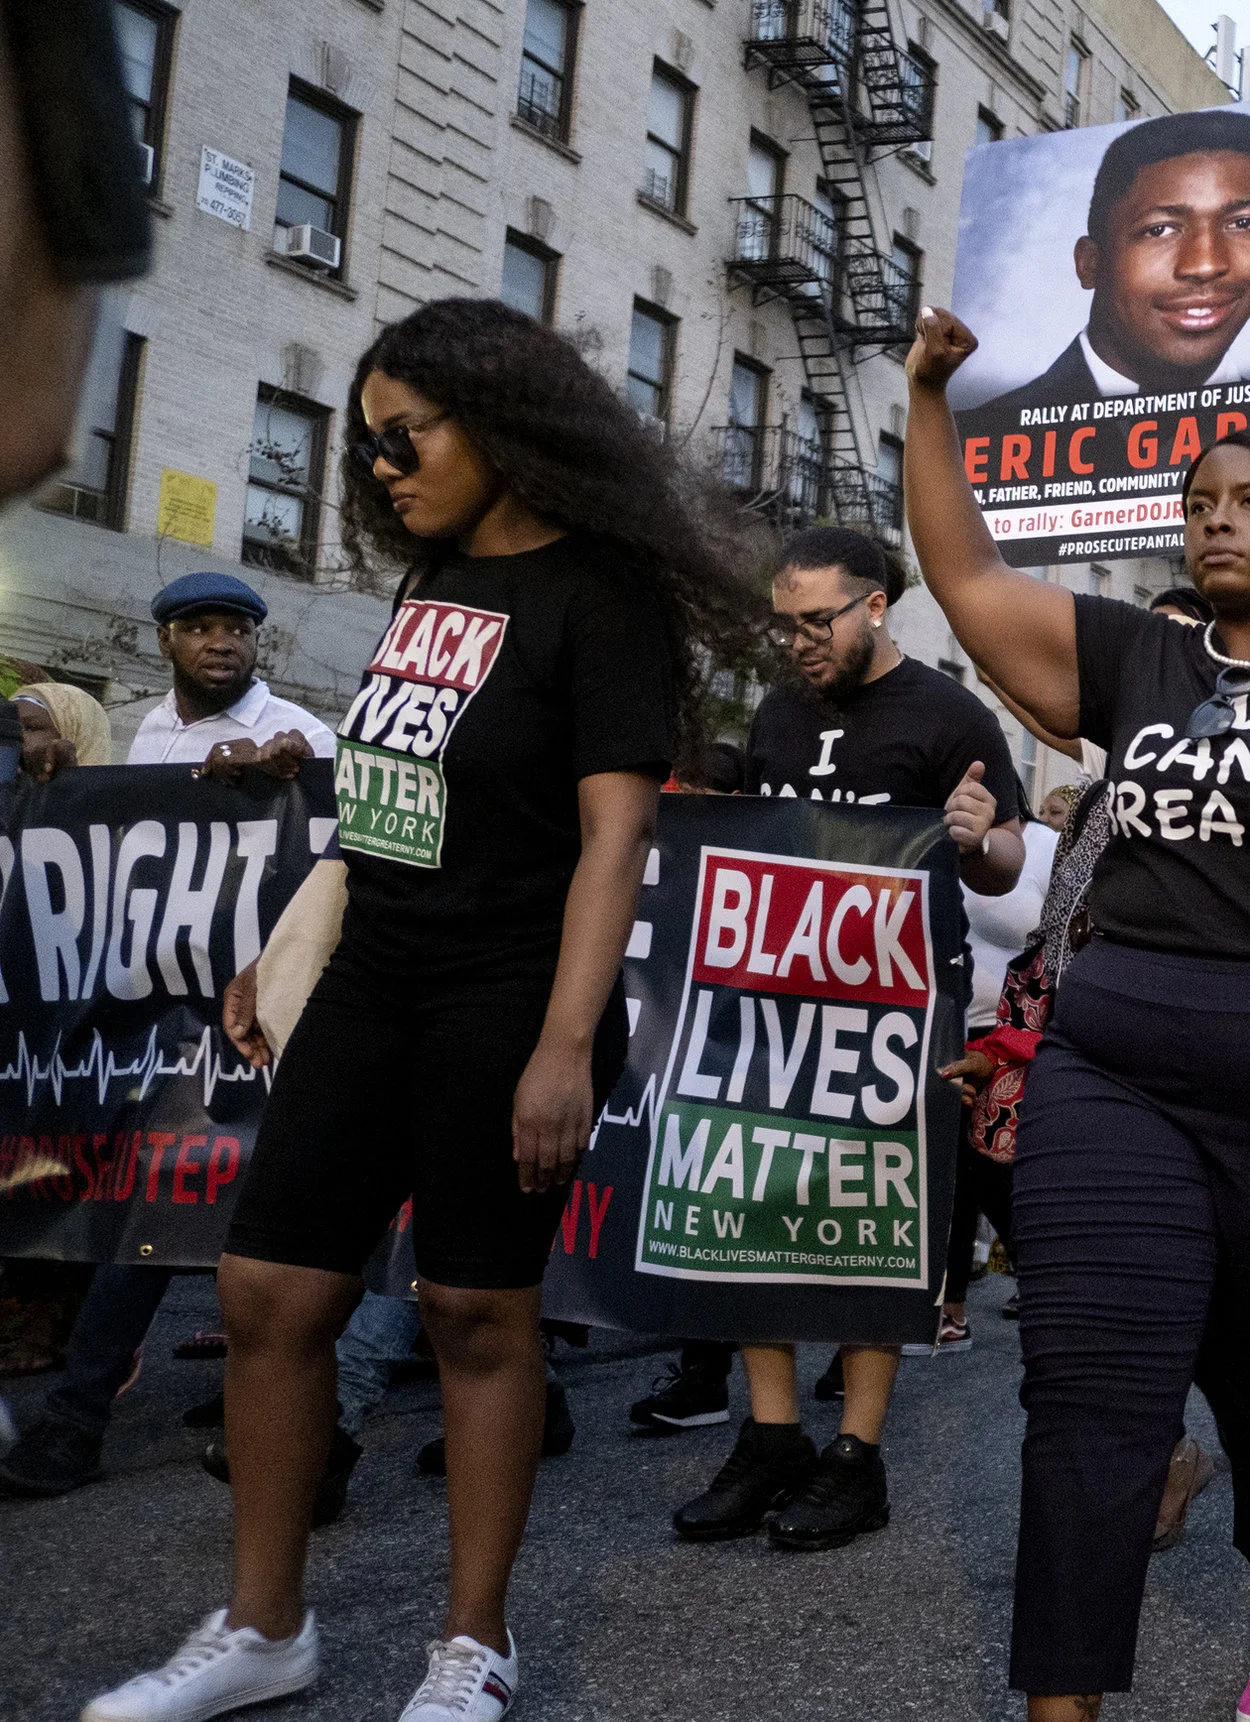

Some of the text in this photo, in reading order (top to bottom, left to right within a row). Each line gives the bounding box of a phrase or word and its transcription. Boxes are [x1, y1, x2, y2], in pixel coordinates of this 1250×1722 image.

[1020, 405, 1068, 426] RALLY
[1071, 403, 1090, 421] AT
[1093, 391, 1197, 419] DEPARTMENT
[1201, 388, 1222, 408] OF
[964, 426, 1097, 484] ERIC
[989, 485, 1042, 503] FATHER,
[1044, 480, 1096, 498] FRIEND,
[1099, 471, 1181, 494] COMMUNITY
[994, 518, 1011, 534] to
[1018, 513, 1064, 533] rally:
[1058, 533, 1185, 557] #PROSECUTEPANTAL
[338, 673, 459, 758] IVES
[809, 729, 844, 776] I
[336, 747, 441, 818] ATTER
[370, 808, 437, 844] YORK
[22, 820, 278, 1001] RIGHT
[703, 866, 928, 991] BLACK
[677, 989, 919, 1126] LIVES
[657, 1113, 919, 1209] MATTER
[653, 1199, 915, 1248] NEW YORK
[649, 1239, 916, 1269] WWW.BLACKLIVESMATTERGREATERNY.COM
